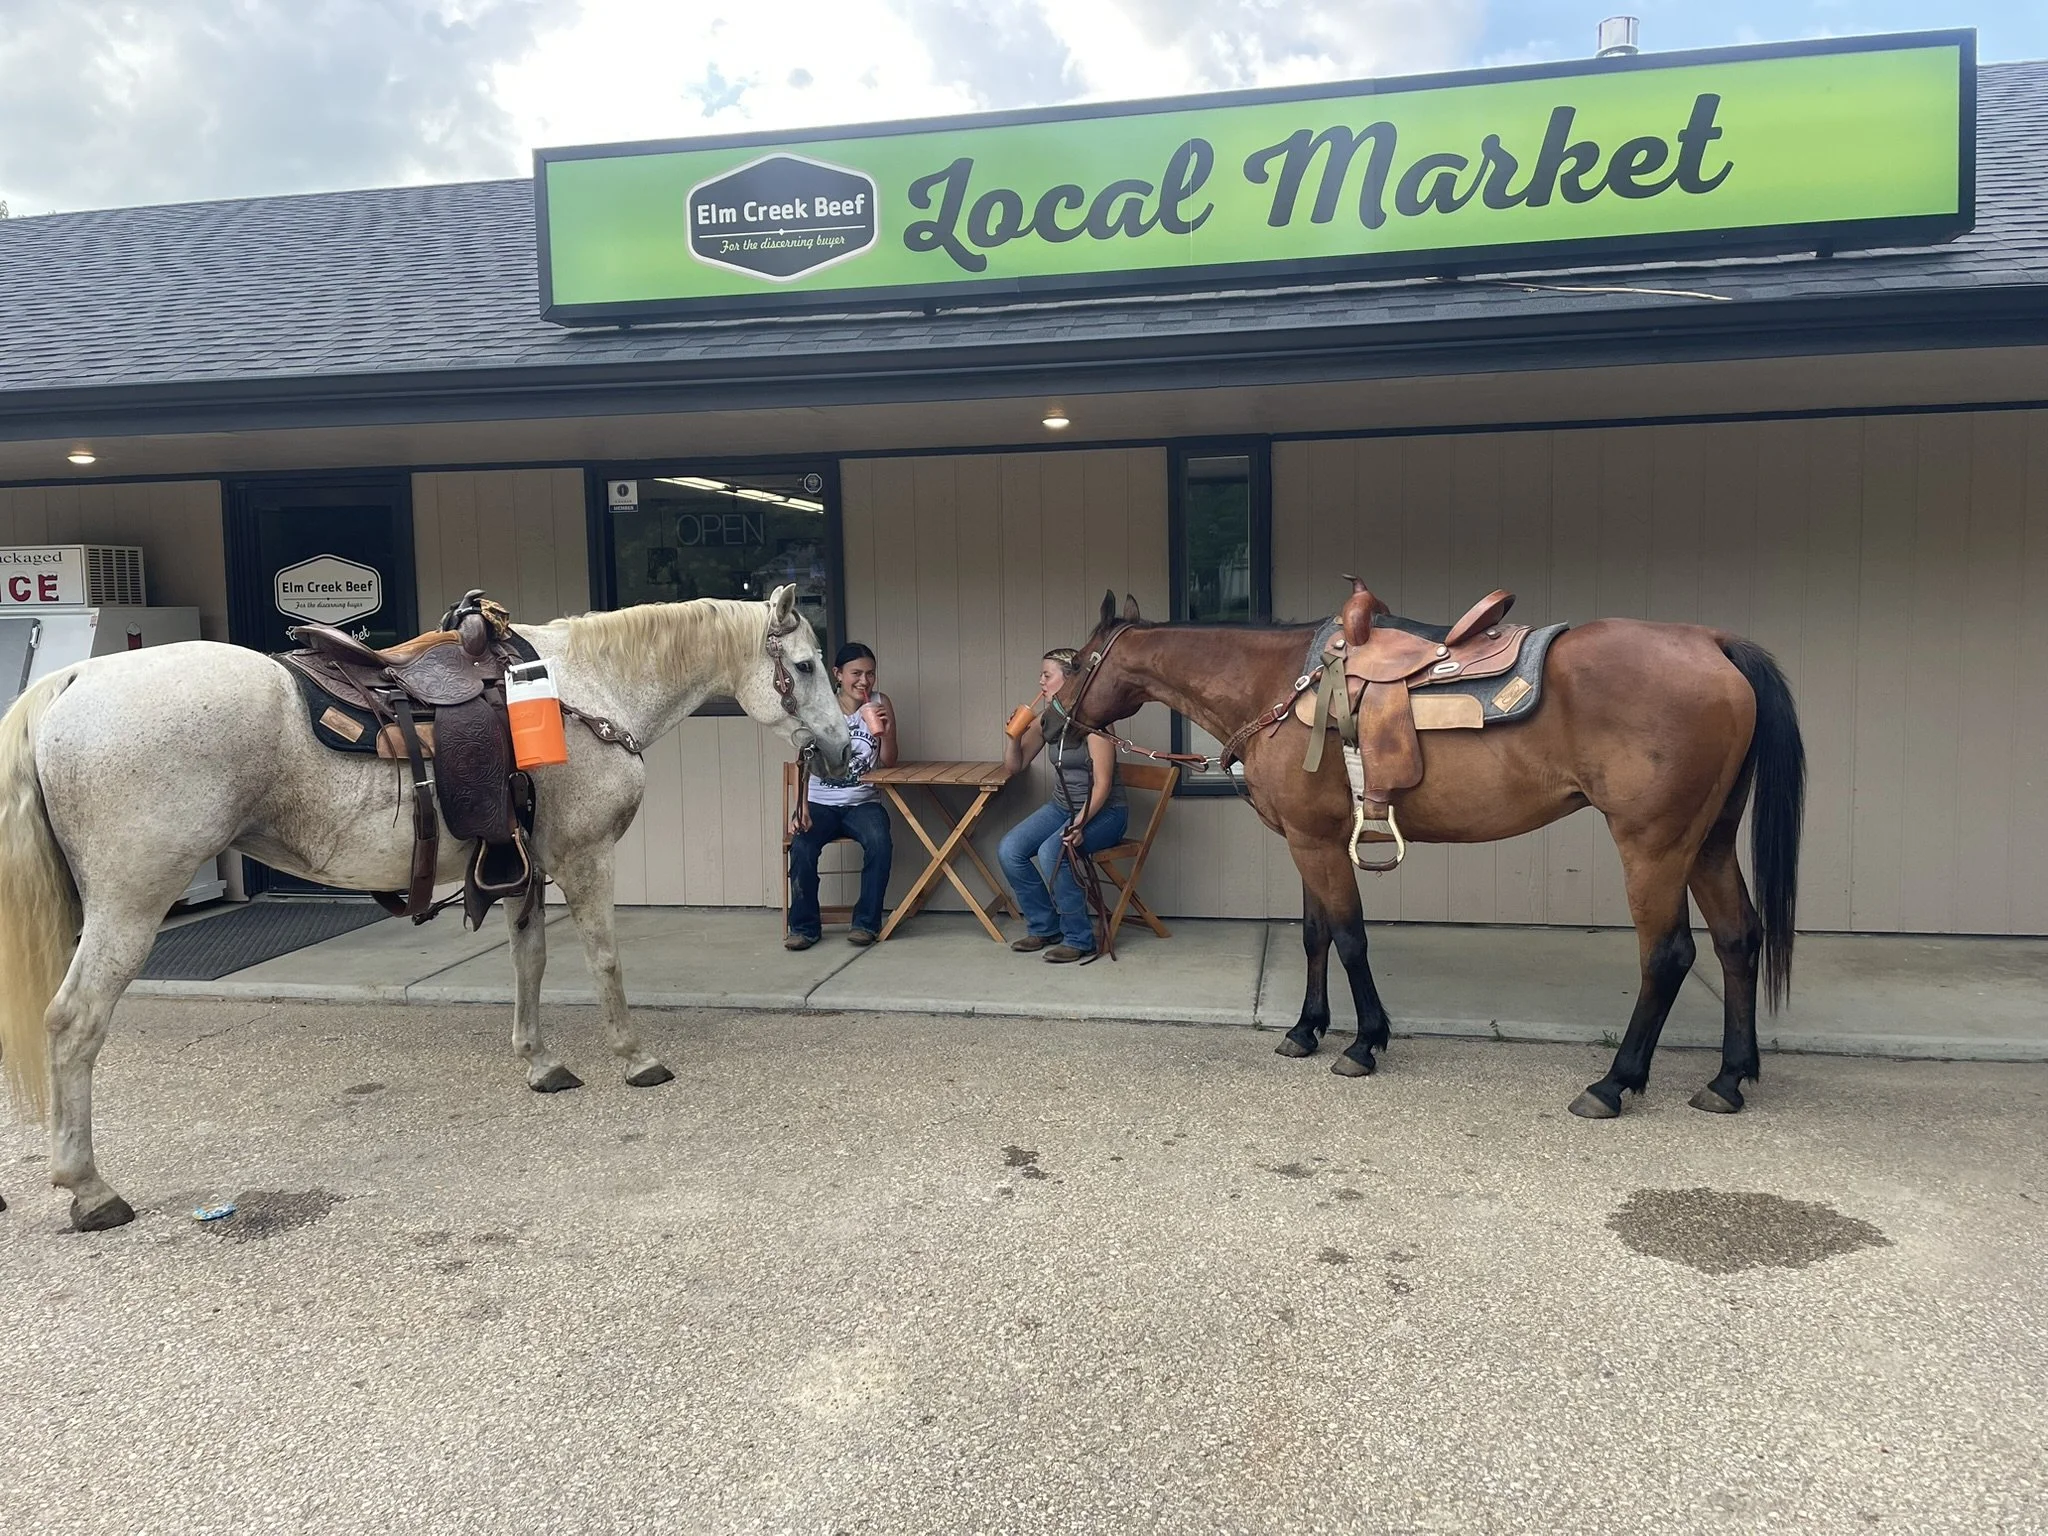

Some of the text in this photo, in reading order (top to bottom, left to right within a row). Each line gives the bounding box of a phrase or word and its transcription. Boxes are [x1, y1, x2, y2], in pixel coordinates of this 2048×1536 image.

[903, 93, 1734, 273] Local Market
[697, 193, 866, 225] Elm Creek Beef
[719, 234, 846, 254] For the discerning buyer
[676, 513, 766, 546] OPEN
[0, 552, 63, 566] ckaged
[0, 573, 60, 603] CE
[282, 580, 373, 593] Elm Creek Beef
